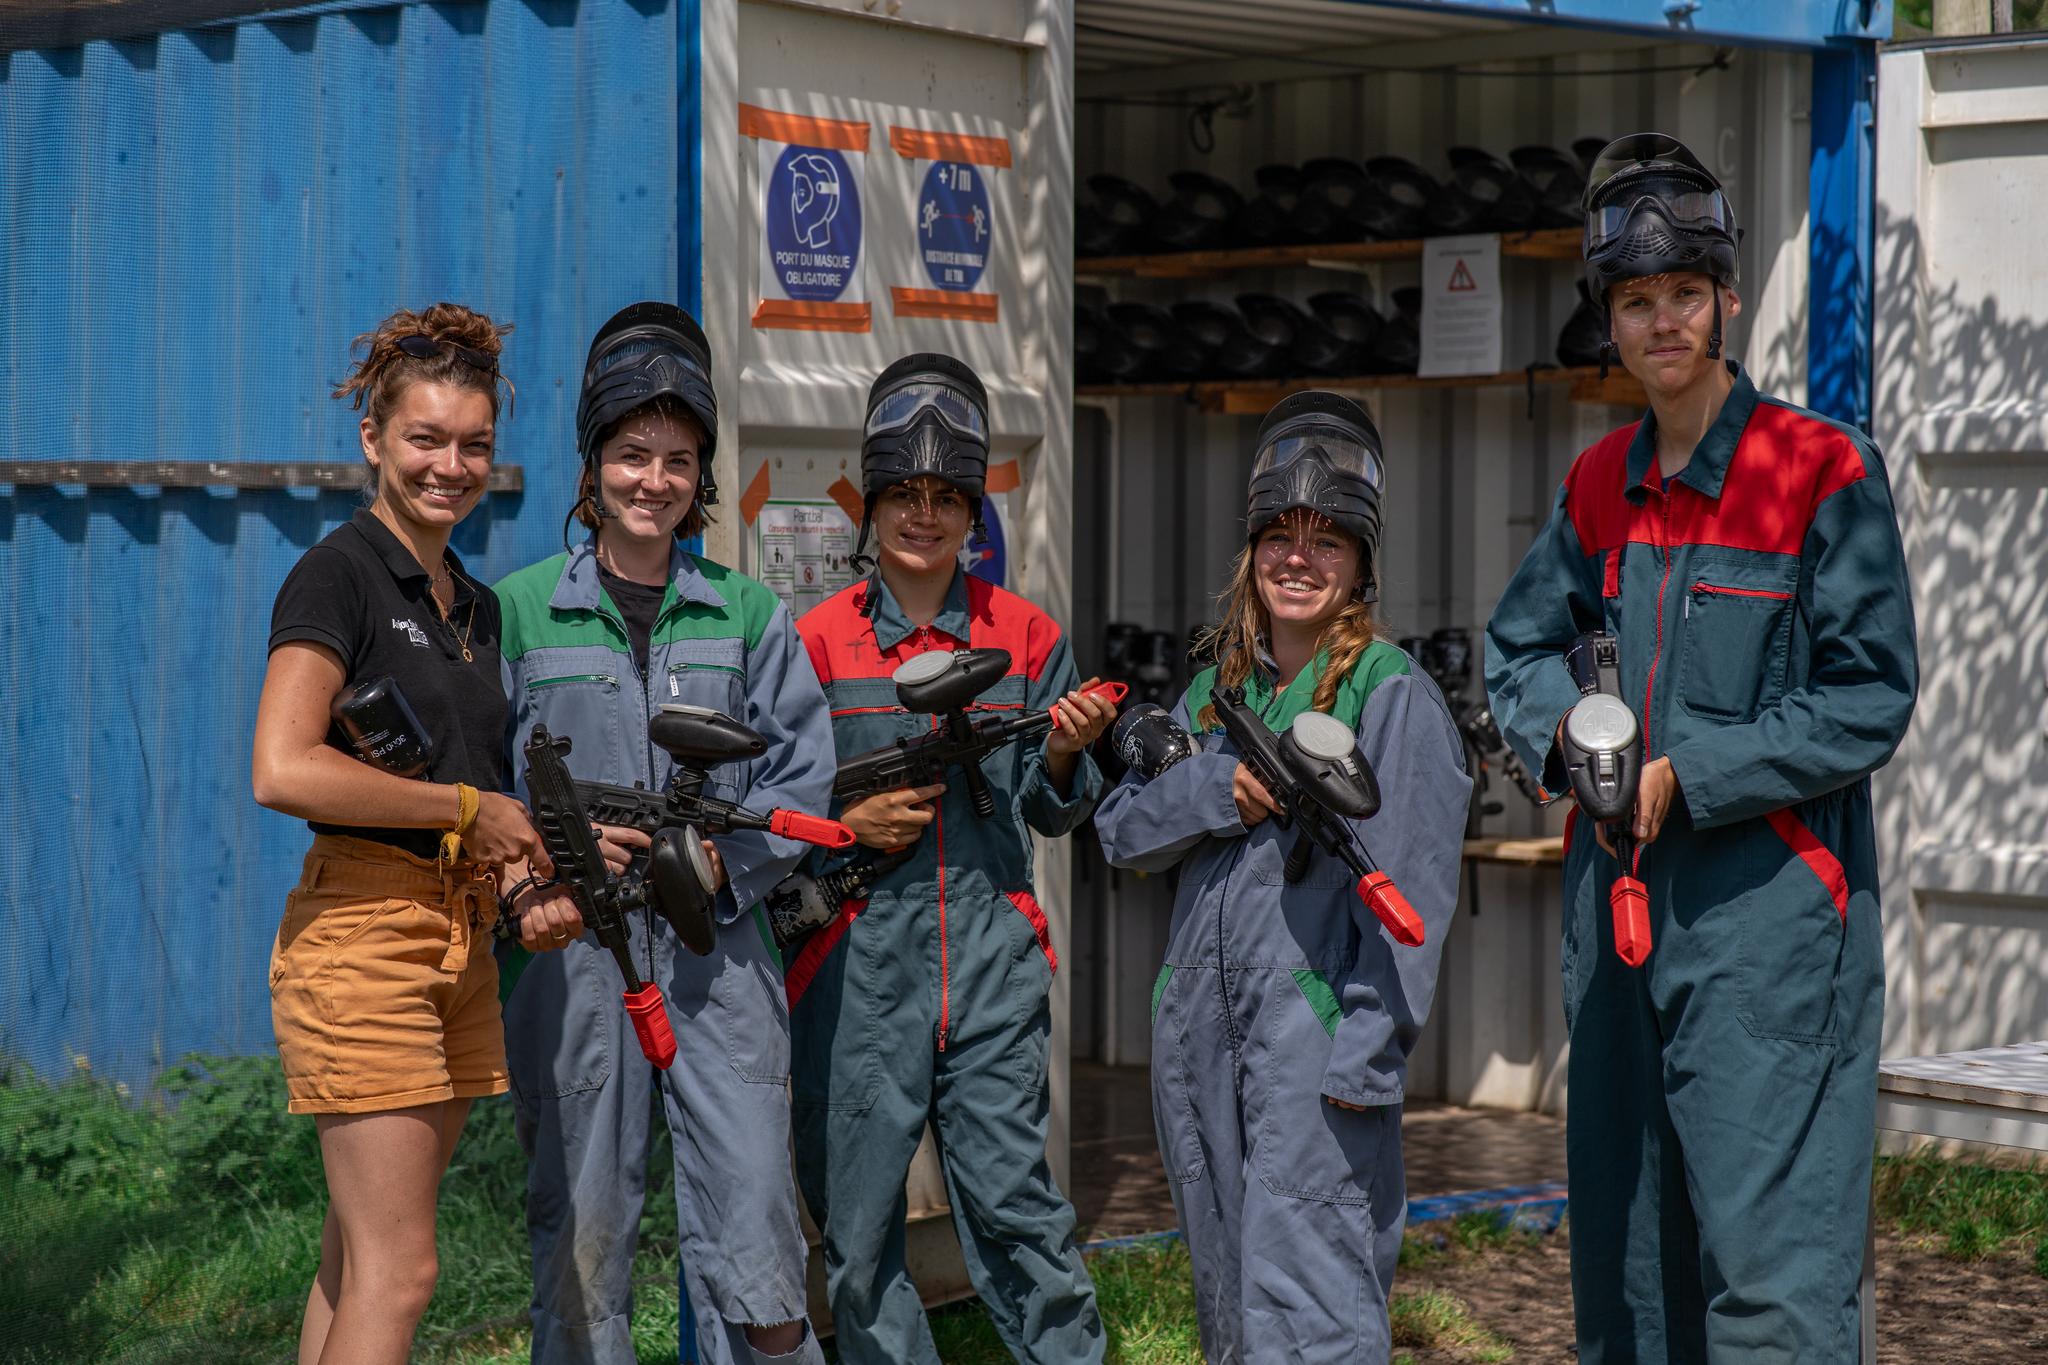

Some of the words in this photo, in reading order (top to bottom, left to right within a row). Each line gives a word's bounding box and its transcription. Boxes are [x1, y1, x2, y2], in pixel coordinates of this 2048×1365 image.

[776, 251, 800, 265] PORT
[801, 253, 813, 266] DU
[814, 254, 851, 269] MASQUE
[925, 249, 954, 264] DISTANCE
[785, 271, 842, 287] OBLIGATOIRE
[944, 268, 953, 282] DE
[953, 269, 964, 283] TIR
[768, 523, 793, 535] Consignes
[370, 746, 387, 759] PSI
